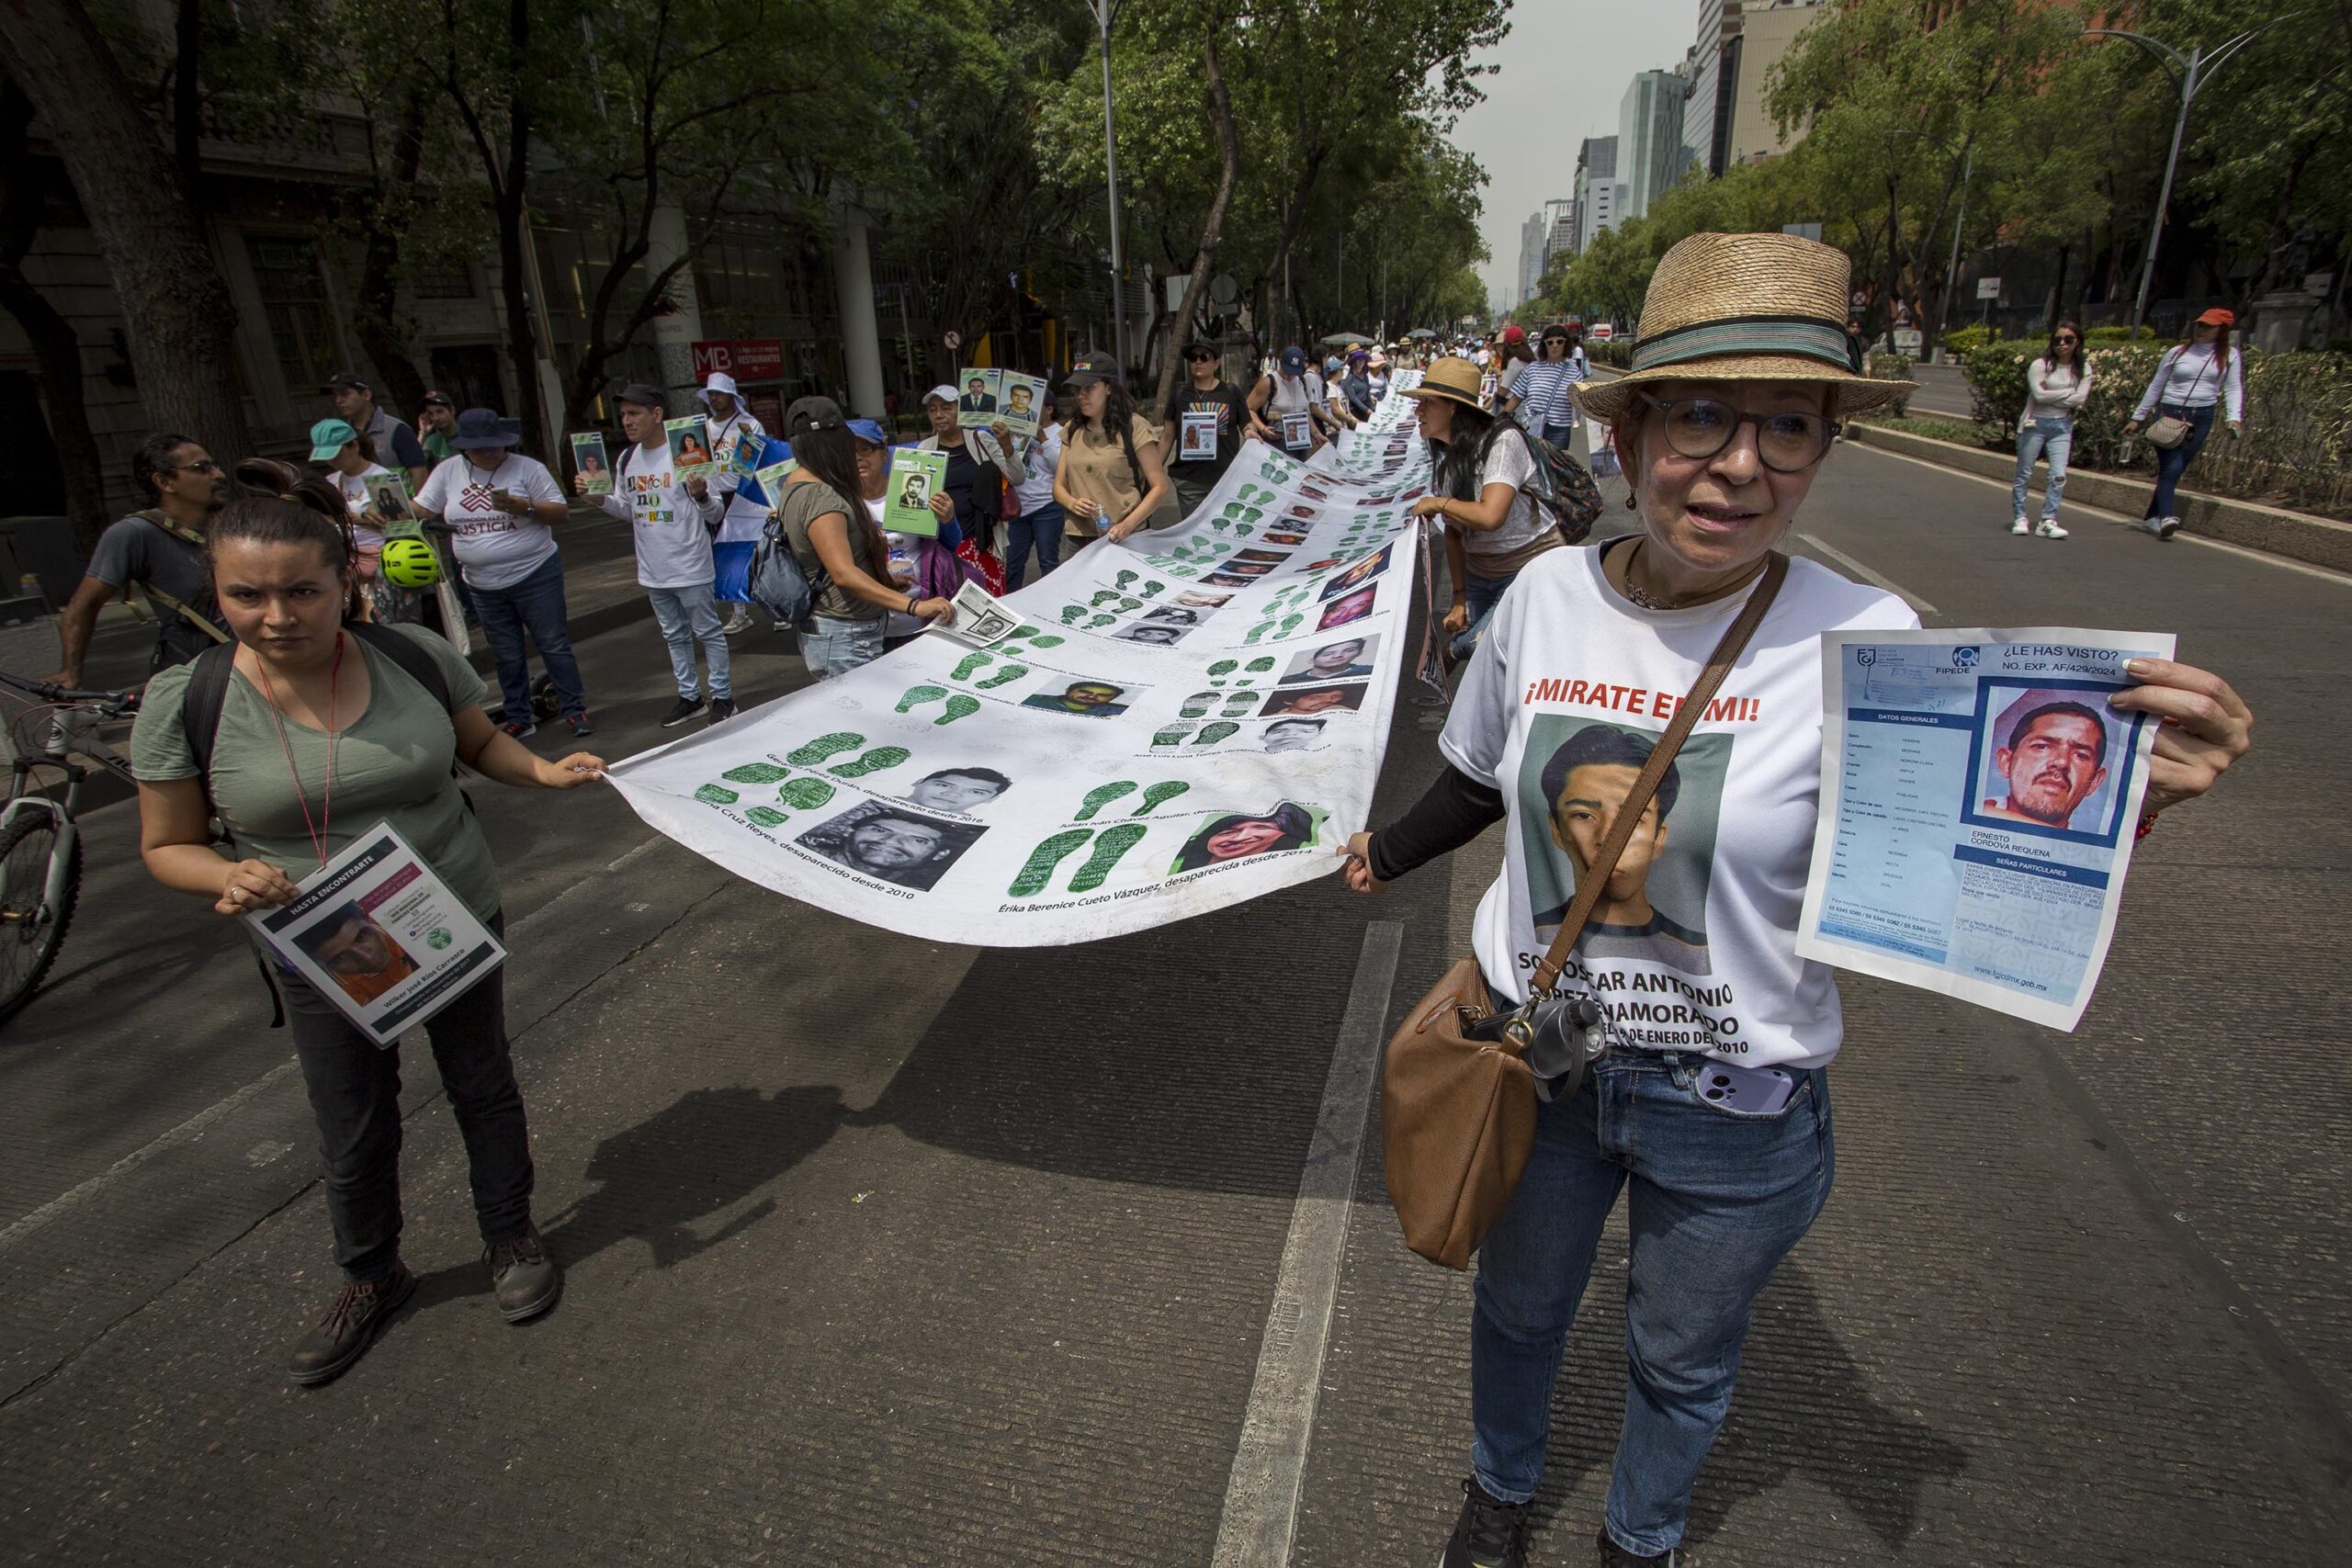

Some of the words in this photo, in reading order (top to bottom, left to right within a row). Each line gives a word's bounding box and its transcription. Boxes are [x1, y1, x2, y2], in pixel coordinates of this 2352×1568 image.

[2004, 646, 2030, 658] ¿LE
[2033, 647, 2063, 657] HAS
[2067, 648, 2119, 661] VISTO?
[2002, 661, 2020, 671] NO.
[2024, 662, 2049, 671] EXP.
[2052, 663, 2116, 676] AF/429/2024
[1524, 678, 1647, 715] ¡MIRATE
[1703, 696, 1761, 722] MI!
[1878, 713, 1899, 721] DATOS
[1900, 715, 1939, 724] GENERALES
[804, 767, 831, 780] Pérez
[831, 776, 862, 793] Durán,
[863, 789, 927, 814] desaparecido
[927, 808, 957, 821] desde
[958, 816, 984, 824] 2016
[1058, 819, 1089, 829] Julián
[1113, 815, 1149, 824] Chávez
[1149, 812, 1191, 821] Aguilar,
[1193, 808, 1265, 818] desaparecido
[1265, 797, 1290, 816] desde
[1971, 837, 2010, 851] CORDOVA
[2011, 844, 2051, 858] REQUENA
[1972, 830, 2010, 843] ERNESTO
[721, 808, 746, 826] Cruz
[745, 822, 777, 845] Reyes,
[780, 841, 851, 880] desaparecido
[851, 872, 887, 892] desde
[886, 886, 915, 900] 2010
[1996, 857, 2018, 867] SEÑAS
[2018, 862, 2067, 877] PARTICULARES
[289, 895, 320, 916] HASTA
[318, 855, 375, 898] ENCONTRARTE
[998, 903, 1025, 914] Érika
[1027, 900, 1076, 912] Berenice
[1077, 896, 1111, 908] Cueto
[1114, 883, 1162, 900] Vázquez,
[1164, 860, 1240, 888] desaparecida
[1241, 852, 1280, 866] desde
[1281, 849, 1313, 859] 2014
[1071, 879, 1102, 887] JALISCO
[1836, 906, 1849, 914] 5345
[1872, 915, 1886, 923] 5345
[1912, 924, 1926, 932] 5345
[383, 991, 408, 1008] Wilker
[406, 980, 423, 995] José
[421, 970, 437, 984] Ríos
[435, 949, 466, 972] Carrasco
[1632, 972, 1734, 1008] ANTONIO
[1973, 965, 2049, 992] www.fgjcdmx.gob.mx
[1629, 1028, 1645, 1042] DE
[1647, 1030, 1690, 1044] ENERO
[1694, 1032, 1715, 1045] DEL
[1715, 1041, 1748, 1055] 2010
